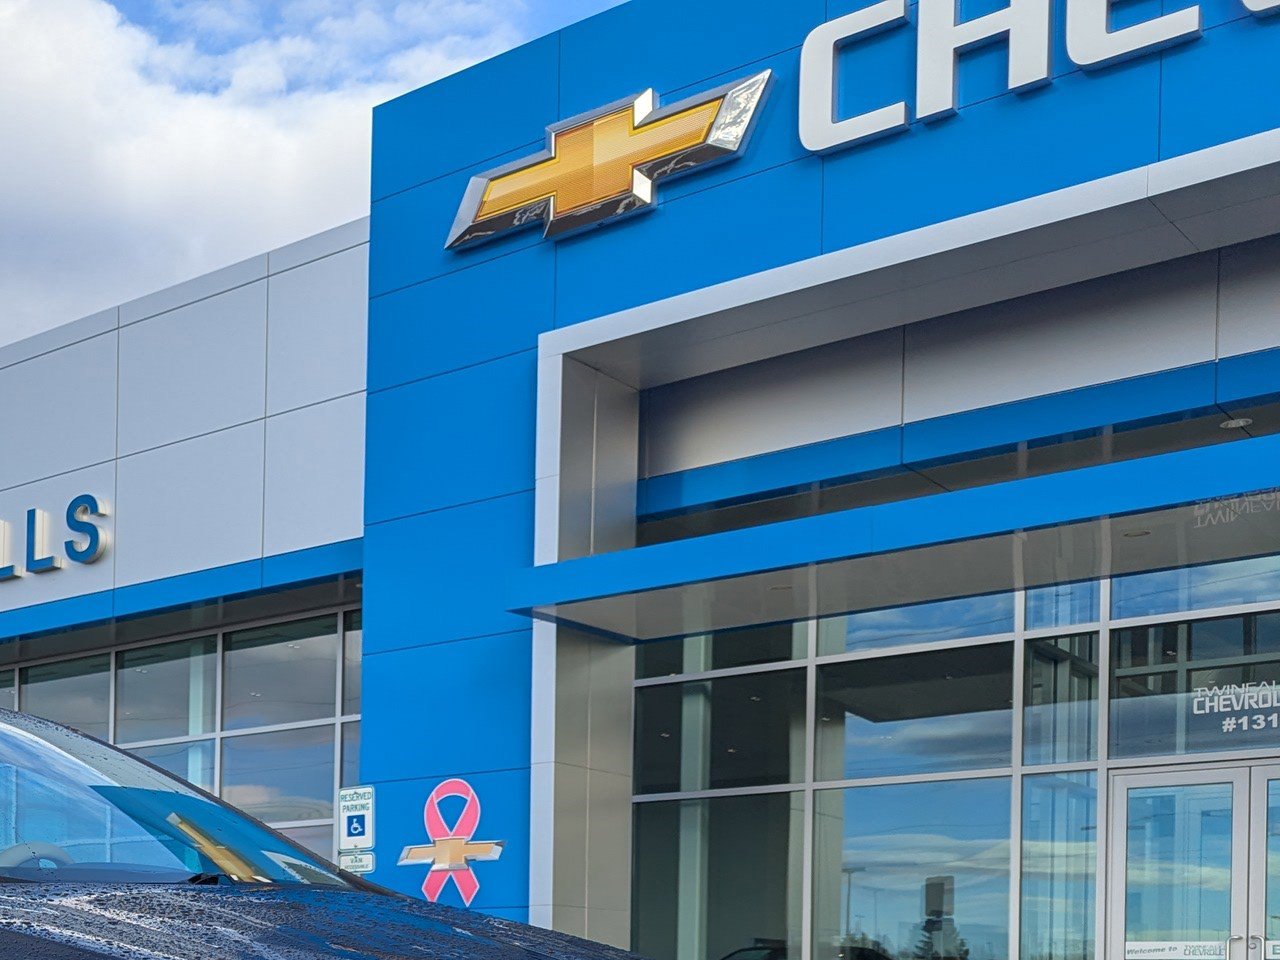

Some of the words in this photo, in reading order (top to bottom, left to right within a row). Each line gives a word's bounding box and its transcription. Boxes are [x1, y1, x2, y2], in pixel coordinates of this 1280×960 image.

[799, 0, 1280, 153] CH
[340, 791, 372, 803] RESERVED
[342, 803, 370, 813] PARKING
[1127, 947, 1166, 955] Welcome
